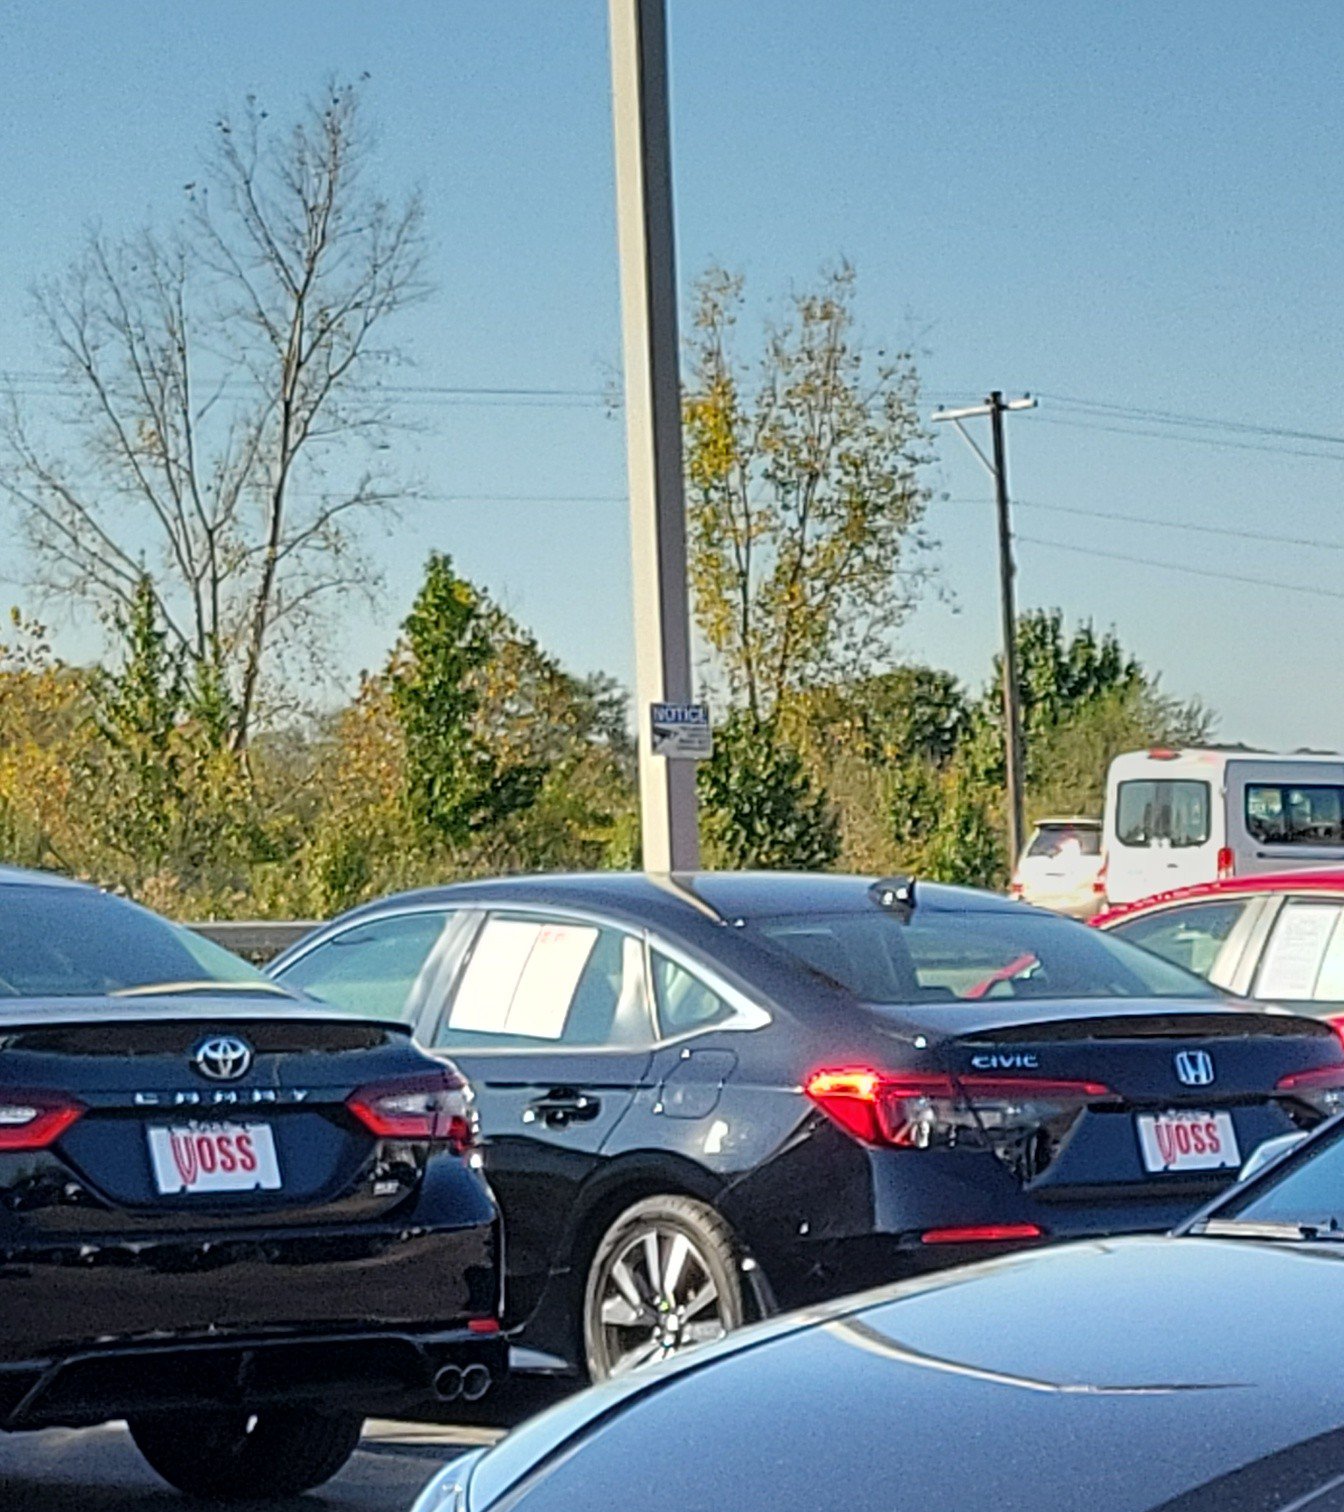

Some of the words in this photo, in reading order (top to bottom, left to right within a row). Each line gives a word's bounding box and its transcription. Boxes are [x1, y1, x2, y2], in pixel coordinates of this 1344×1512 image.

[971, 1054, 1038, 1069] CIVIC
[170, 1133, 257, 1185] VOSS
[1154, 1122, 1221, 1165] VOSS
